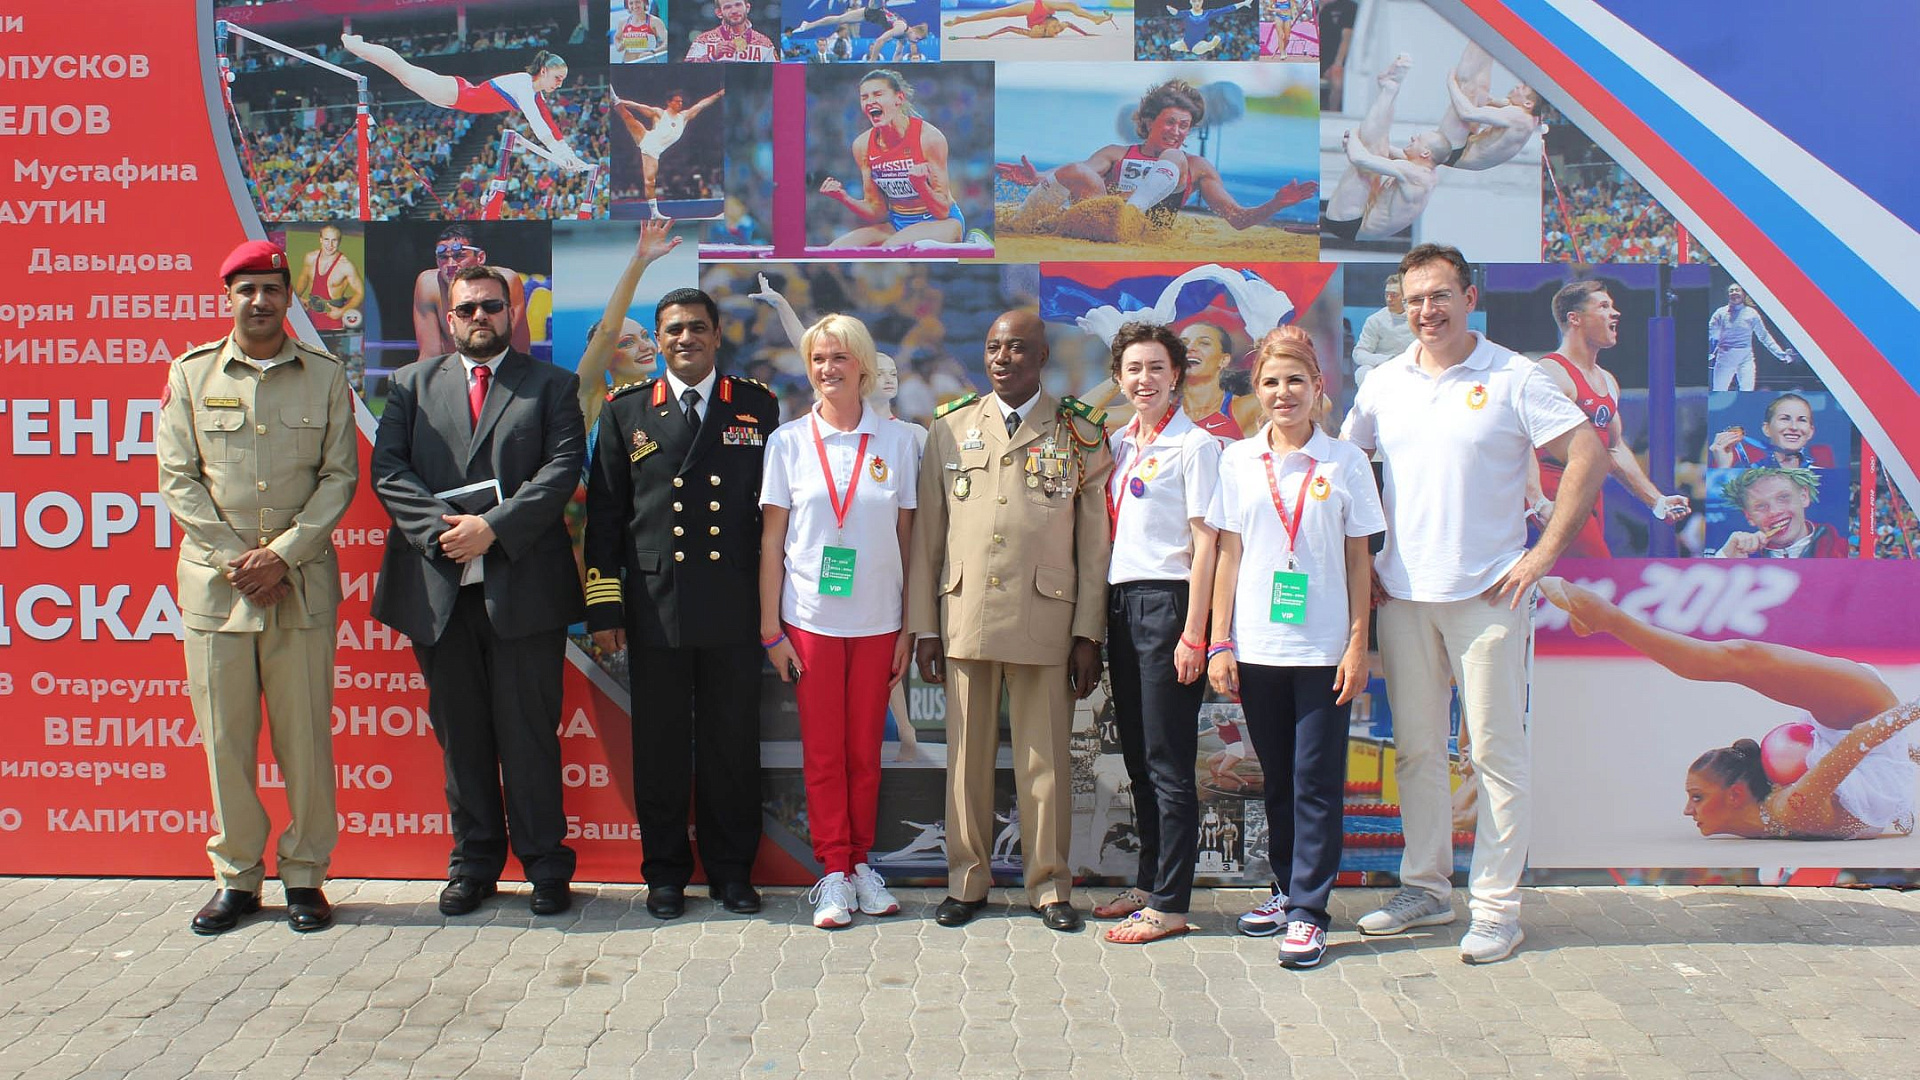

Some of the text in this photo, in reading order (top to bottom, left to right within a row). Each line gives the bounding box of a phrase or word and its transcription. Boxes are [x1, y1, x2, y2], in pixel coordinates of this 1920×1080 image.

[0, 16, 23, 33] и
[706, 45, 763, 61] RSIA
[0, 54, 150, 79] ПУСКОВ
[0, 104, 111, 136] ЕЛОВ
[14, 157, 198, 189] Мустафина
[0, 200, 106, 225] АУТИН
[28, 248, 192, 274] Давыдова
[0, 303, 74, 329] орян
[0, 338, 172, 364] ИНБАЕВА
[0, 399, 162, 462] ЕНД
[331, 528, 390, 548] дне
[1618, 562, 1801, 637] 2012
[0, 584, 184, 646] СКА
[909, 687, 947, 720] RUS
[556, 708, 597, 738] А
[1, 760, 167, 786] илозерчев
[1222, 863, 1232, 871] 3
